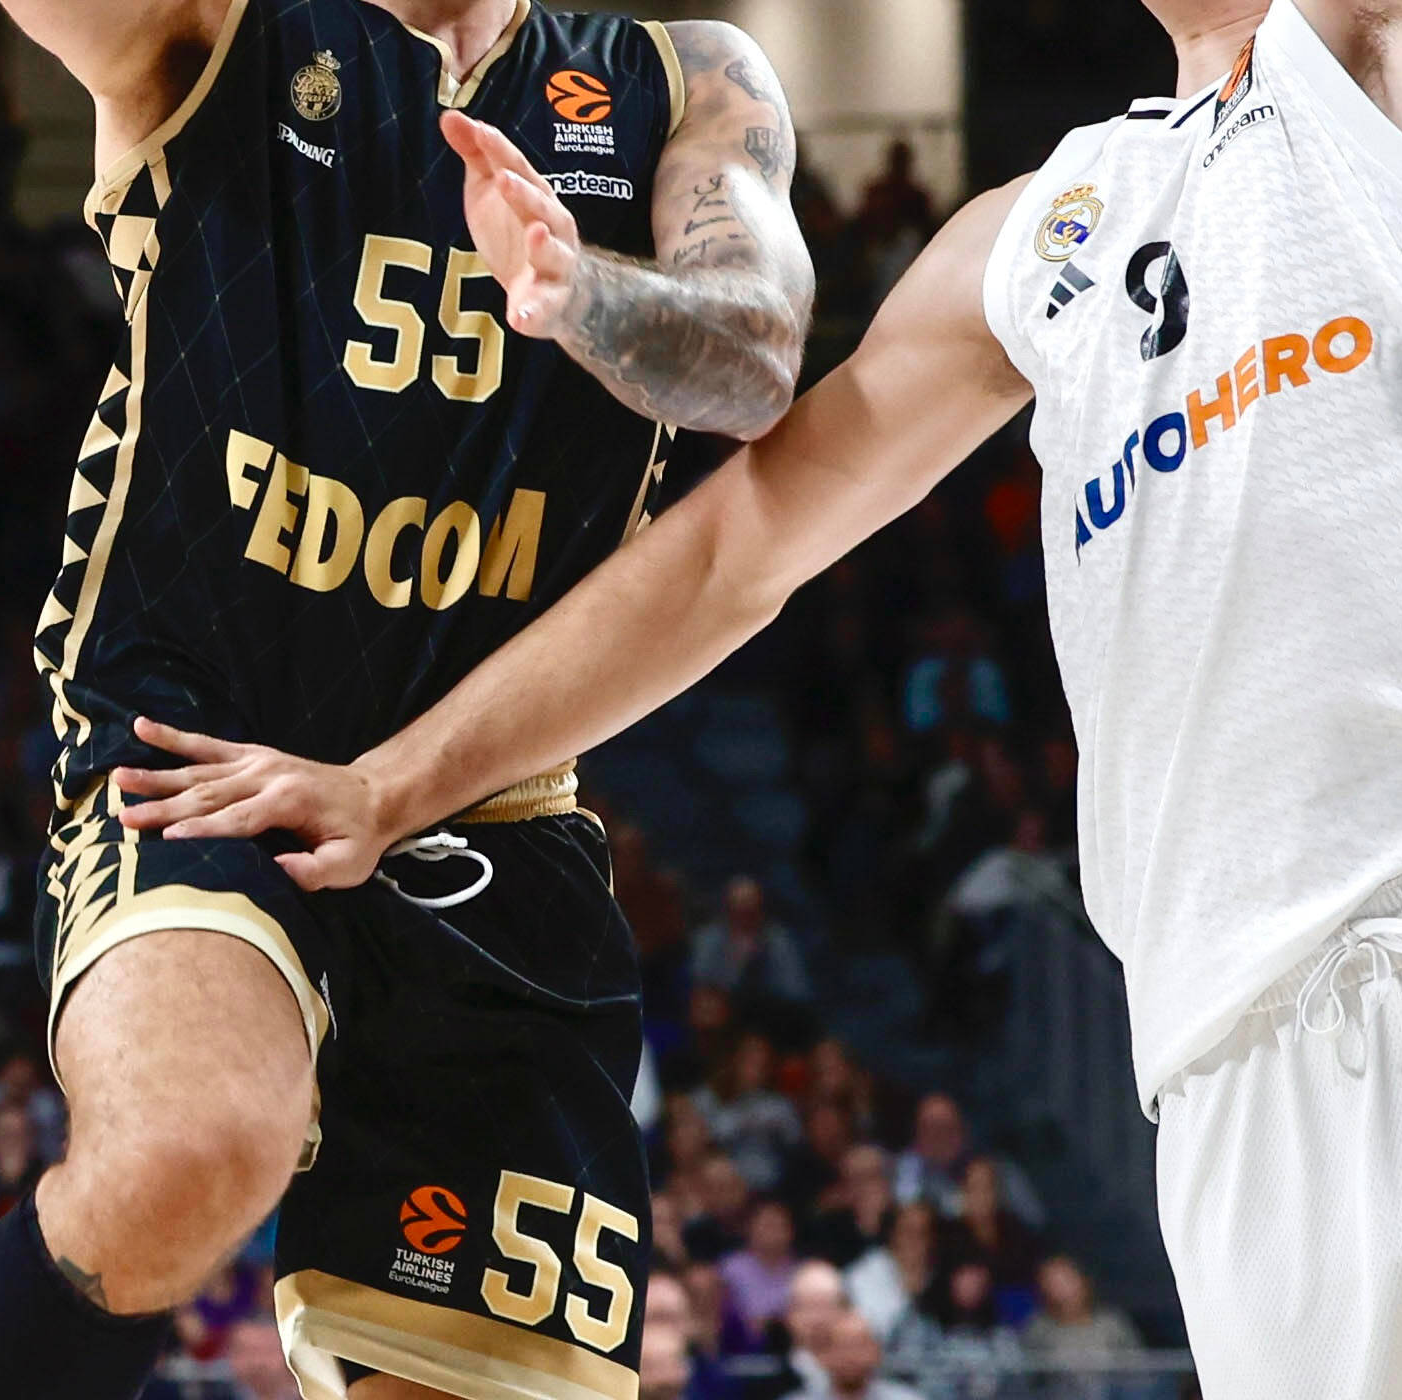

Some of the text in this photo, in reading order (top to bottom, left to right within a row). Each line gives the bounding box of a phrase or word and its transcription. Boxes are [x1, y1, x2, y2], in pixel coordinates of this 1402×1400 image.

[553, 123, 614, 136] TURKISH
[554, 133, 615, 146] AIRLINES
[554, 143, 616, 156] EuroLeague
[545, 170, 633, 200] neteam
[1125, 241, 1190, 362] 9
[342, 233, 505, 403] 55
[391, 1260, 453, 1285] AIRLINES
[396, 1248, 455, 1273] TURKISH
[480, 1169, 640, 1354] 55
[388, 1270, 450, 1294] EuroLeague
